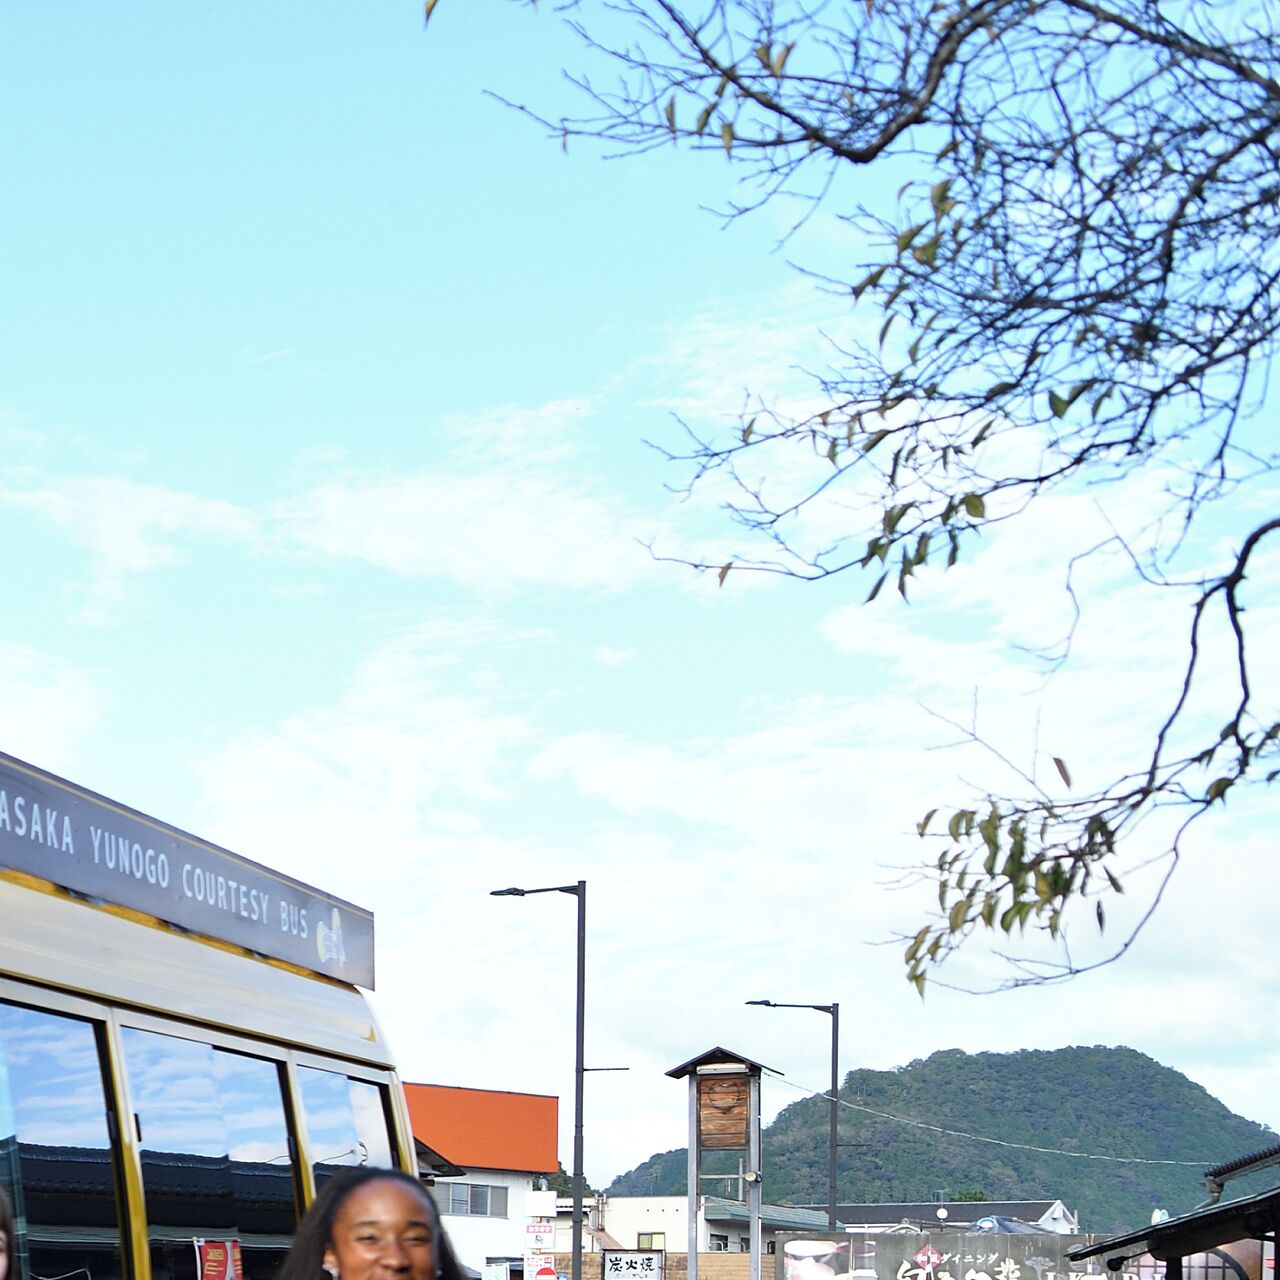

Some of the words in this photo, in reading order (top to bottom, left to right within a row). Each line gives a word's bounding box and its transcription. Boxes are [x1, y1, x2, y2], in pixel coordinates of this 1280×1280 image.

[90, 826, 170, 888] YUNOGO
[182, 864, 270, 924] COURTESY
[280, 901, 309, 939] BUS
[609, 1256, 655, 1273] 炭火焼
